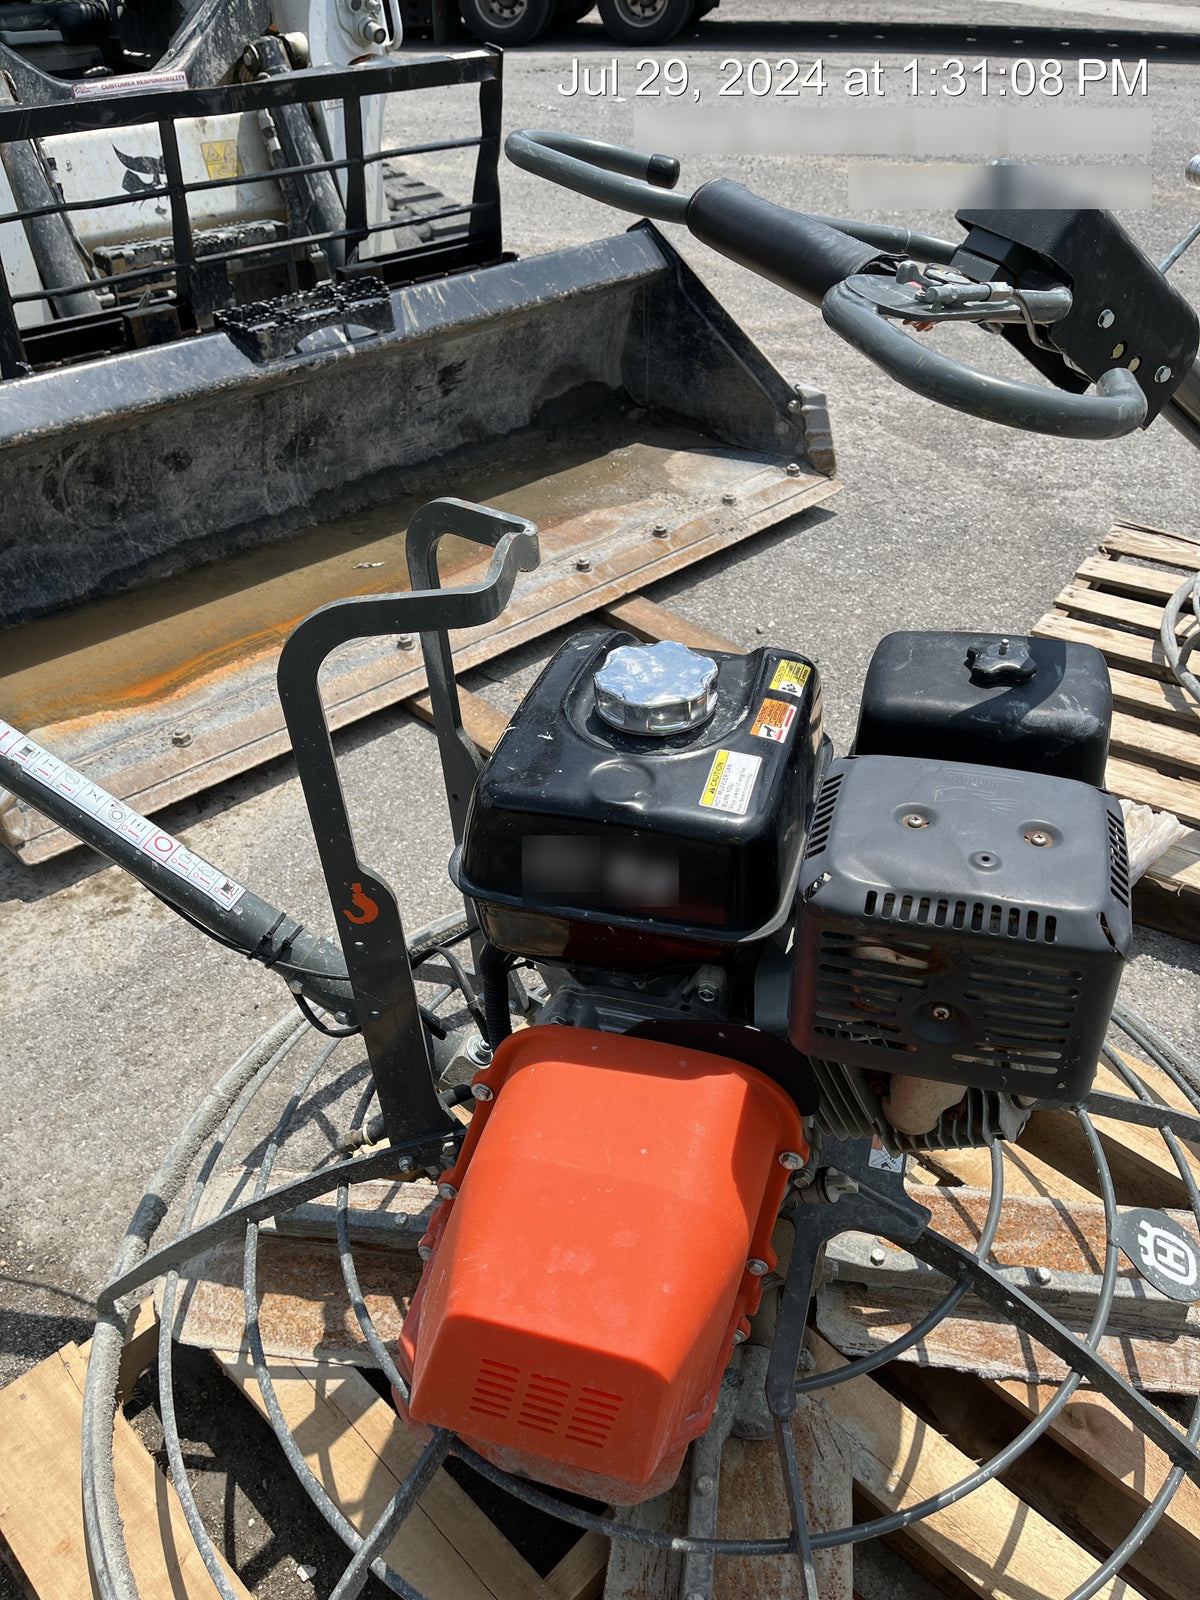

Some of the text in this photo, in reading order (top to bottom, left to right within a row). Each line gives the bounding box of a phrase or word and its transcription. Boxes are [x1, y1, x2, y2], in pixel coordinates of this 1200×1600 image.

[101, 81, 135, 90] CUSTOMER
[136, 75, 185, 86] RESPONSIBILITY
[710, 762, 724, 786] CAUTION
[718, 774, 728, 797] MUFFLER
[721, 793, 730, 807] BURN
